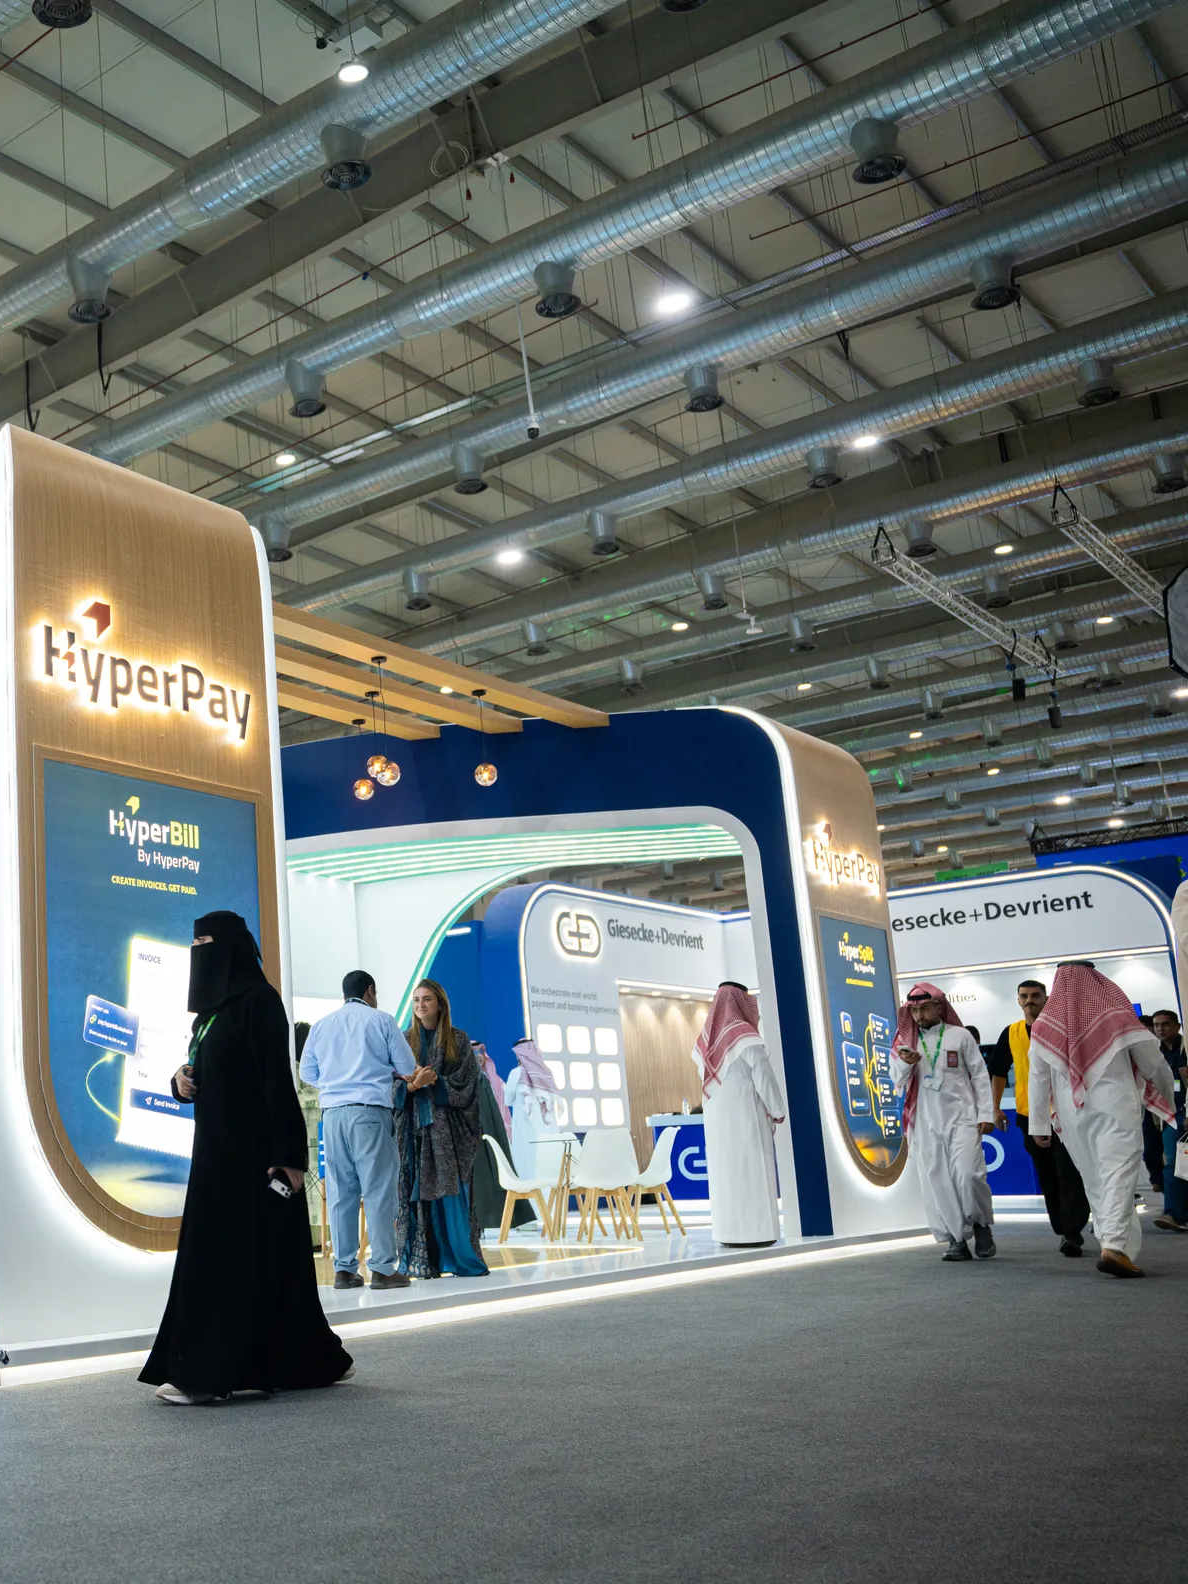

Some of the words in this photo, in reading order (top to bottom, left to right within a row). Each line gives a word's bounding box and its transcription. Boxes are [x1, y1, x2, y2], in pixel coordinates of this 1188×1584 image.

[43, 624, 252, 741] HyperPay
[109, 808, 200, 850] HyperBill
[137, 848, 151, 867] By
[152, 851, 200, 875] HyperPay
[812, 840, 883, 896] HyperPay
[111, 875, 136, 887] CREATE
[168, 884, 181, 894] GET
[891, 891, 1094, 932] esecke+Devrient
[607, 918, 705, 951] Giesecke+Devrient
[137, 952, 162, 965] INVOICE
[530, 985, 540, 995] We
[540, 987, 571, 998] orchestrate
[571, 989, 581, 999] real
[582, 991, 598, 1001] world
[531, 1000, 556, 1011] payment
[556, 1002, 567, 1010] and
[567, 1002, 589, 1015] banking
[589, 1006, 619, 1016] experiences
[153, 1098, 166, 1108] Send
